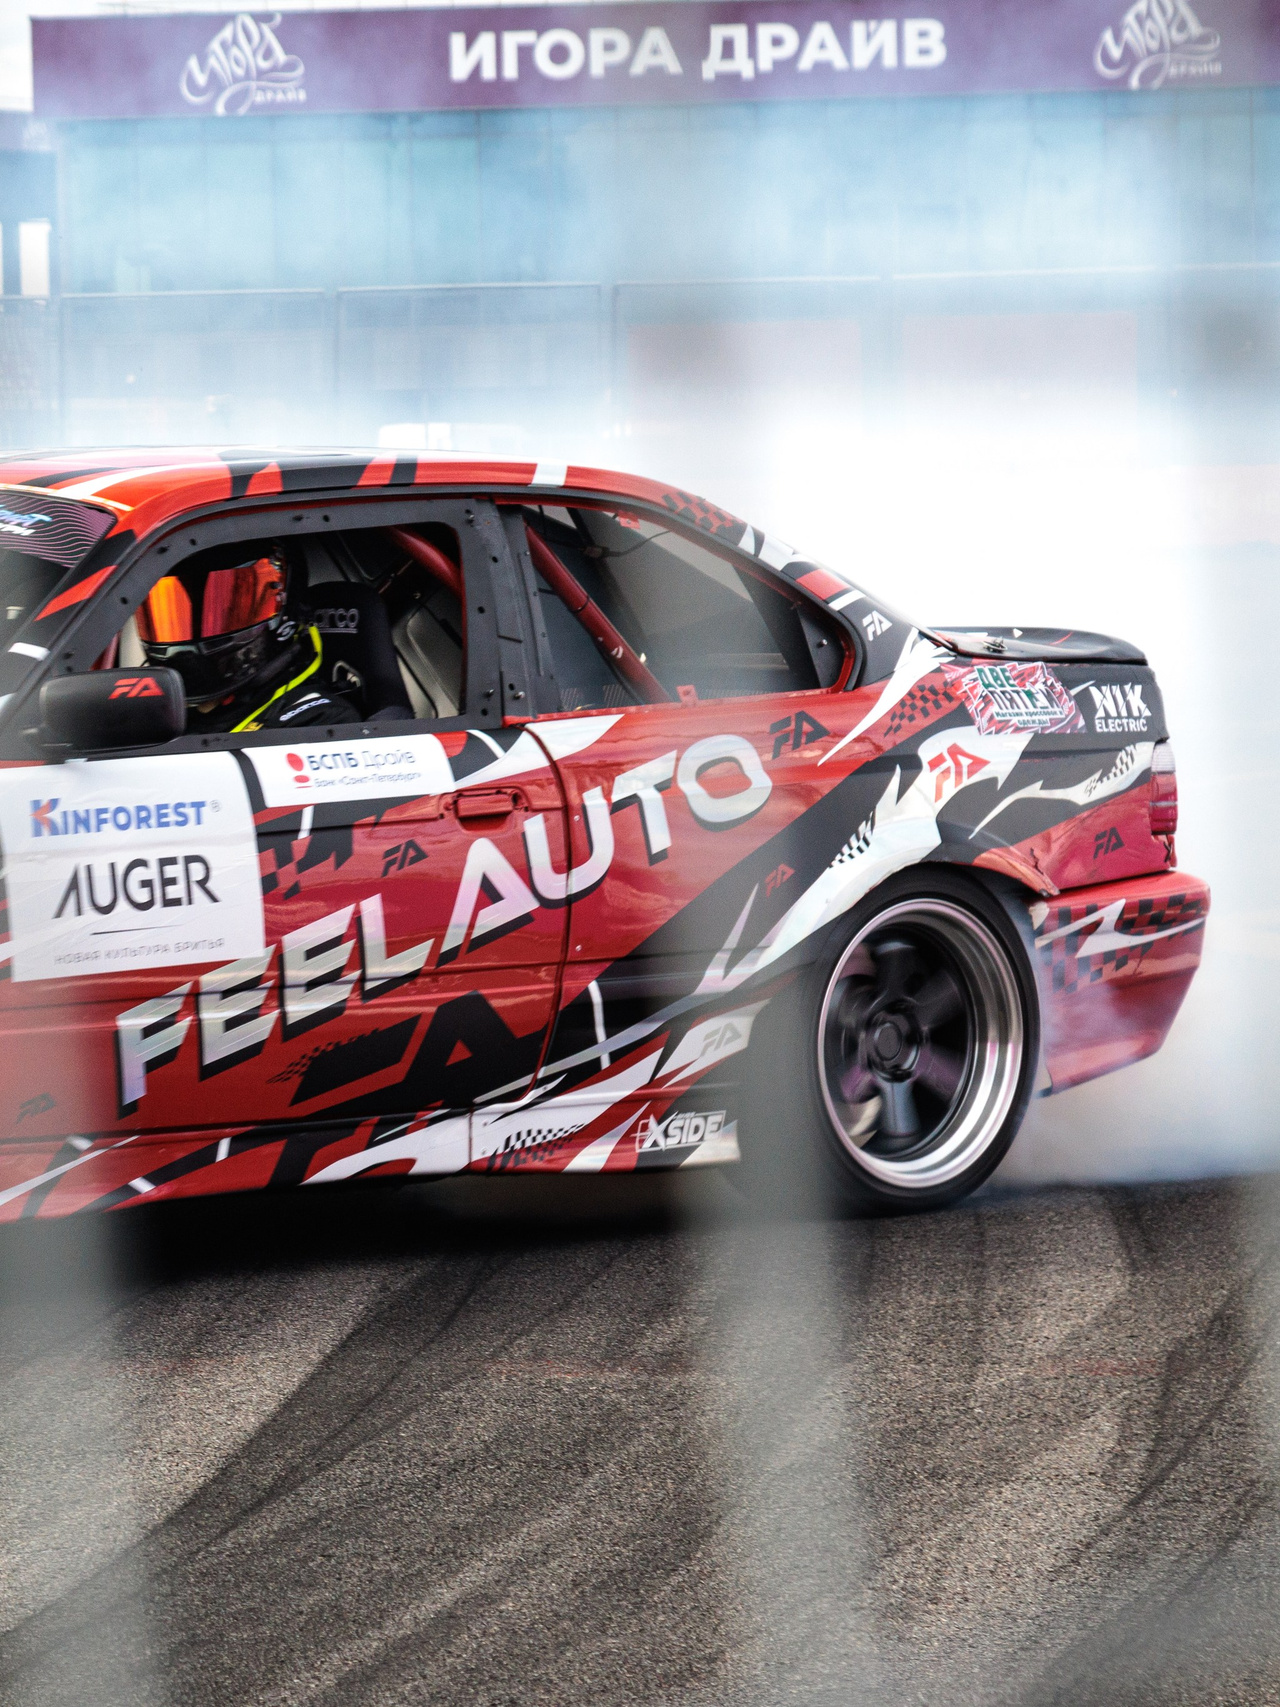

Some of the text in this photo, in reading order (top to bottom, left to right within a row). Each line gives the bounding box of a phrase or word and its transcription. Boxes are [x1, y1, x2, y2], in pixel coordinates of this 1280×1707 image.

[448, 17, 949, 82] ИГОРА ДРАЙВ
[108, 677, 165, 700] FA
[1089, 682, 1152, 719] NIK
[770, 710, 831, 760] FA
[1095, 719, 1148, 733] ELECTRIC
[306, 749, 416, 771] БСПБ Драйв
[927, 743, 991, 803] FA
[382, 839, 429, 877] FA
[51, 854, 222, 919] AUGER
